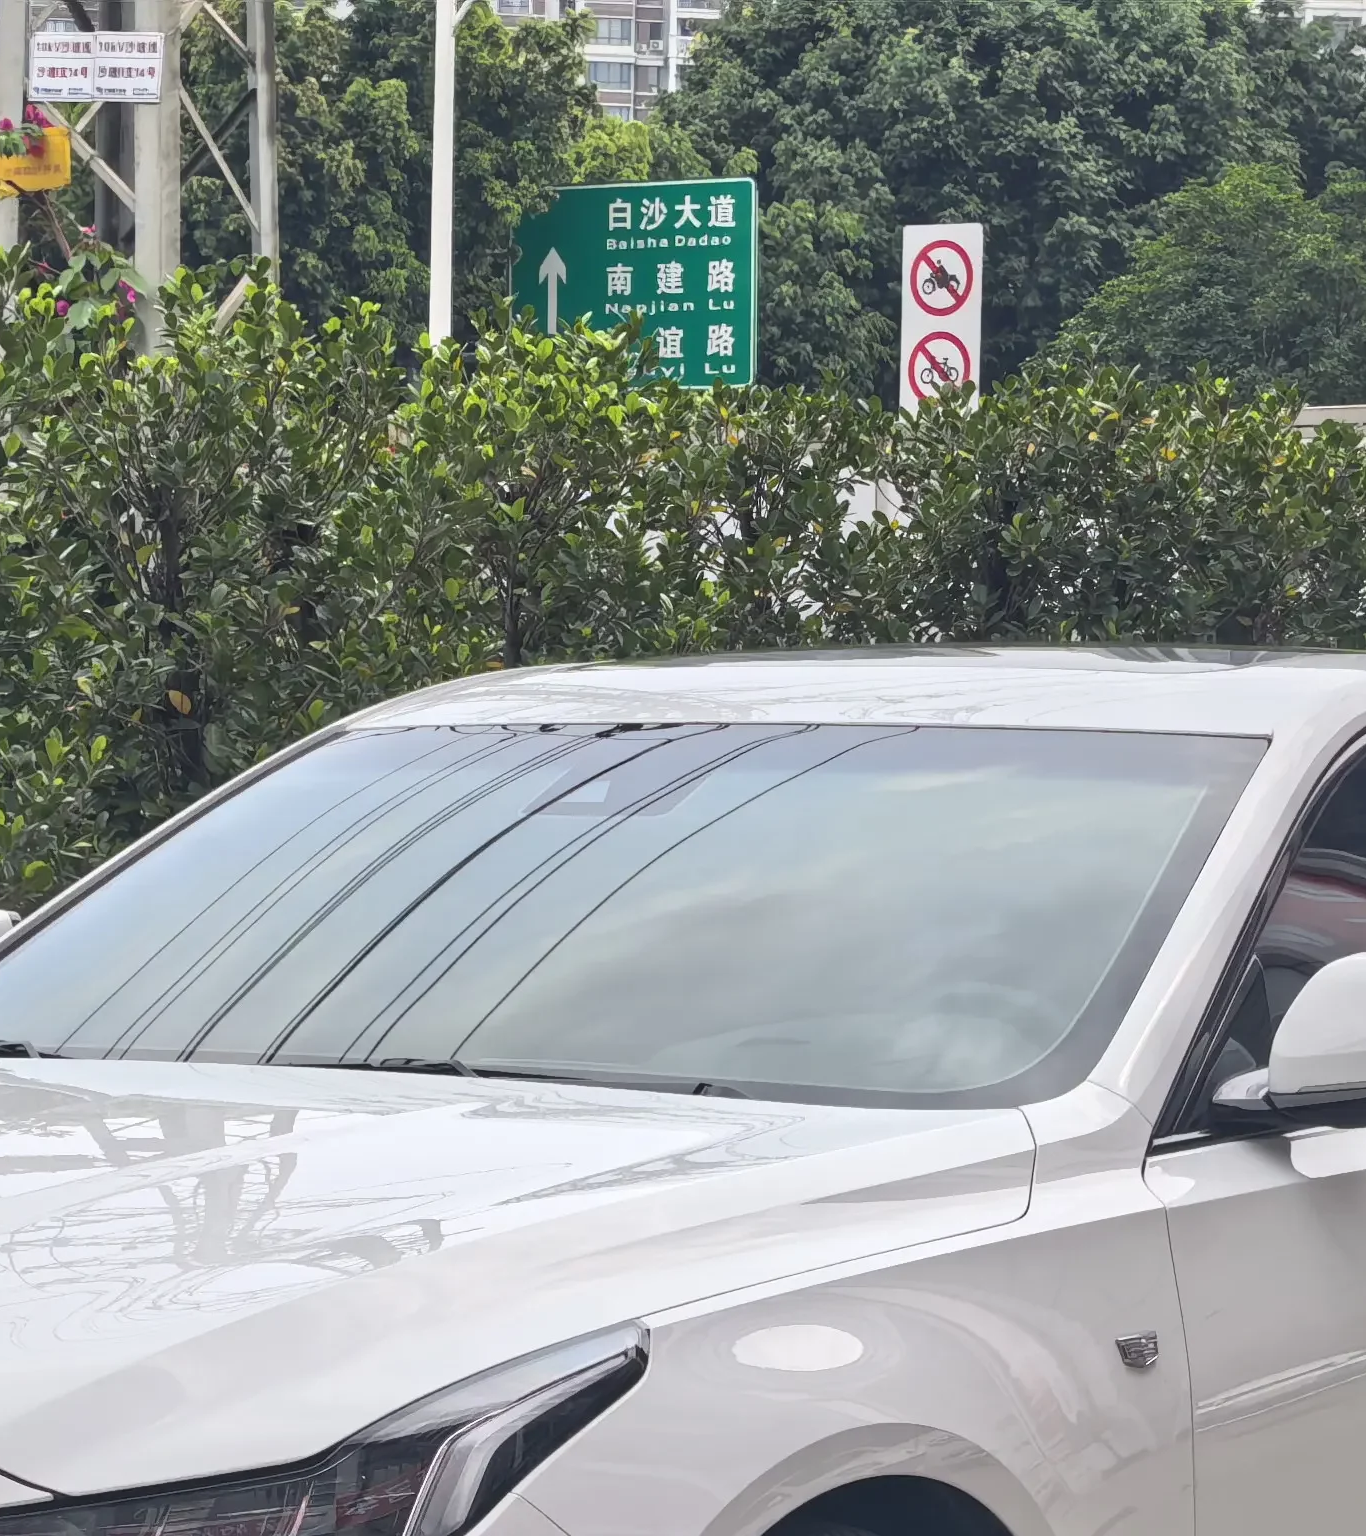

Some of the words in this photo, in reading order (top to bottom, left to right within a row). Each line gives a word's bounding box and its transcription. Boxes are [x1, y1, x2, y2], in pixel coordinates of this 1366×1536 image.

[608, 194, 736, 231] 白沙大道
[606, 236, 669, 251] Baisha
[674, 234, 732, 247] Dadao
[605, 258, 736, 297] 南建路
[605, 300, 695, 316] Nanjian
[708, 298, 735, 311] Lu
[704, 362, 736, 375] Lu
